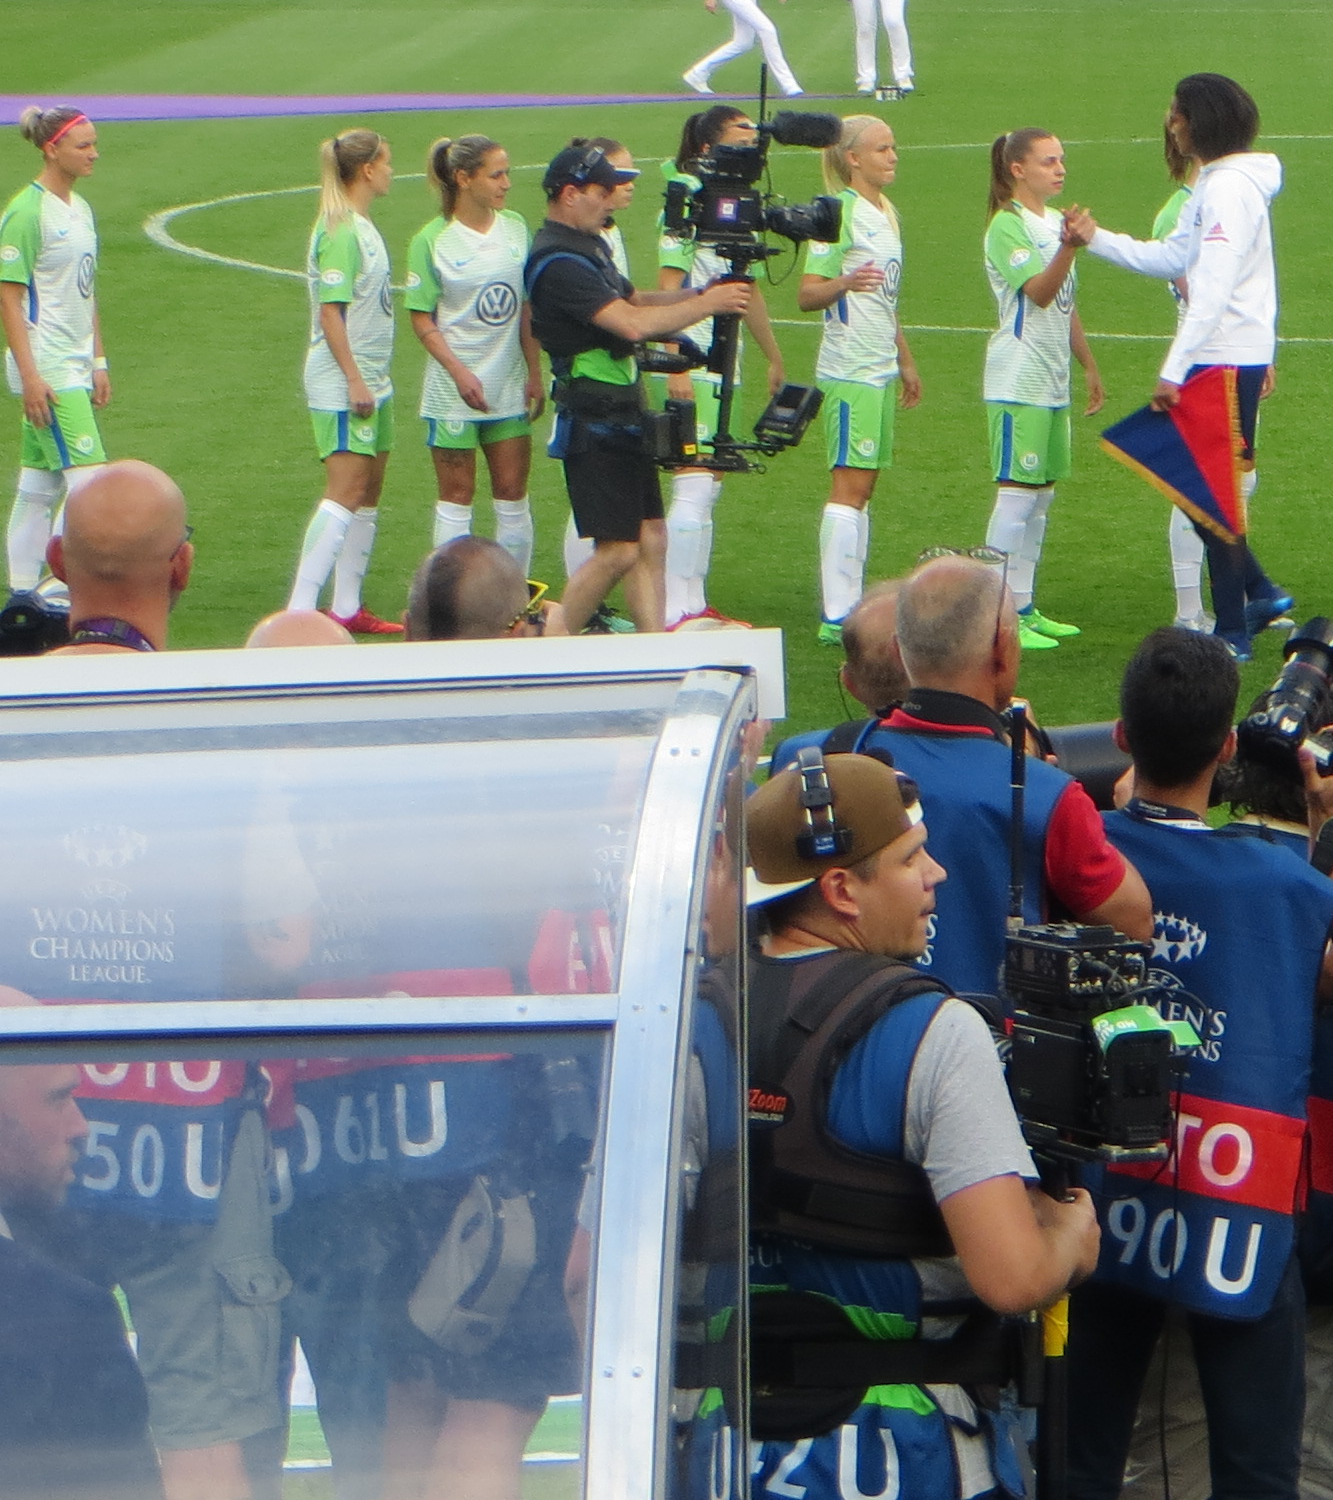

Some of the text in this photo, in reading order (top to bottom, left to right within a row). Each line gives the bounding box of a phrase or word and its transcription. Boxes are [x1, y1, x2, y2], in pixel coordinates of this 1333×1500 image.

[32, 906, 176, 937] WOMEN'S
[29, 936, 175, 963] CHAMPIONS
[69, 964, 152, 985] LEAGUE
[1204, 1216, 1264, 1295] U
[839, 1423, 900, 1500] U
